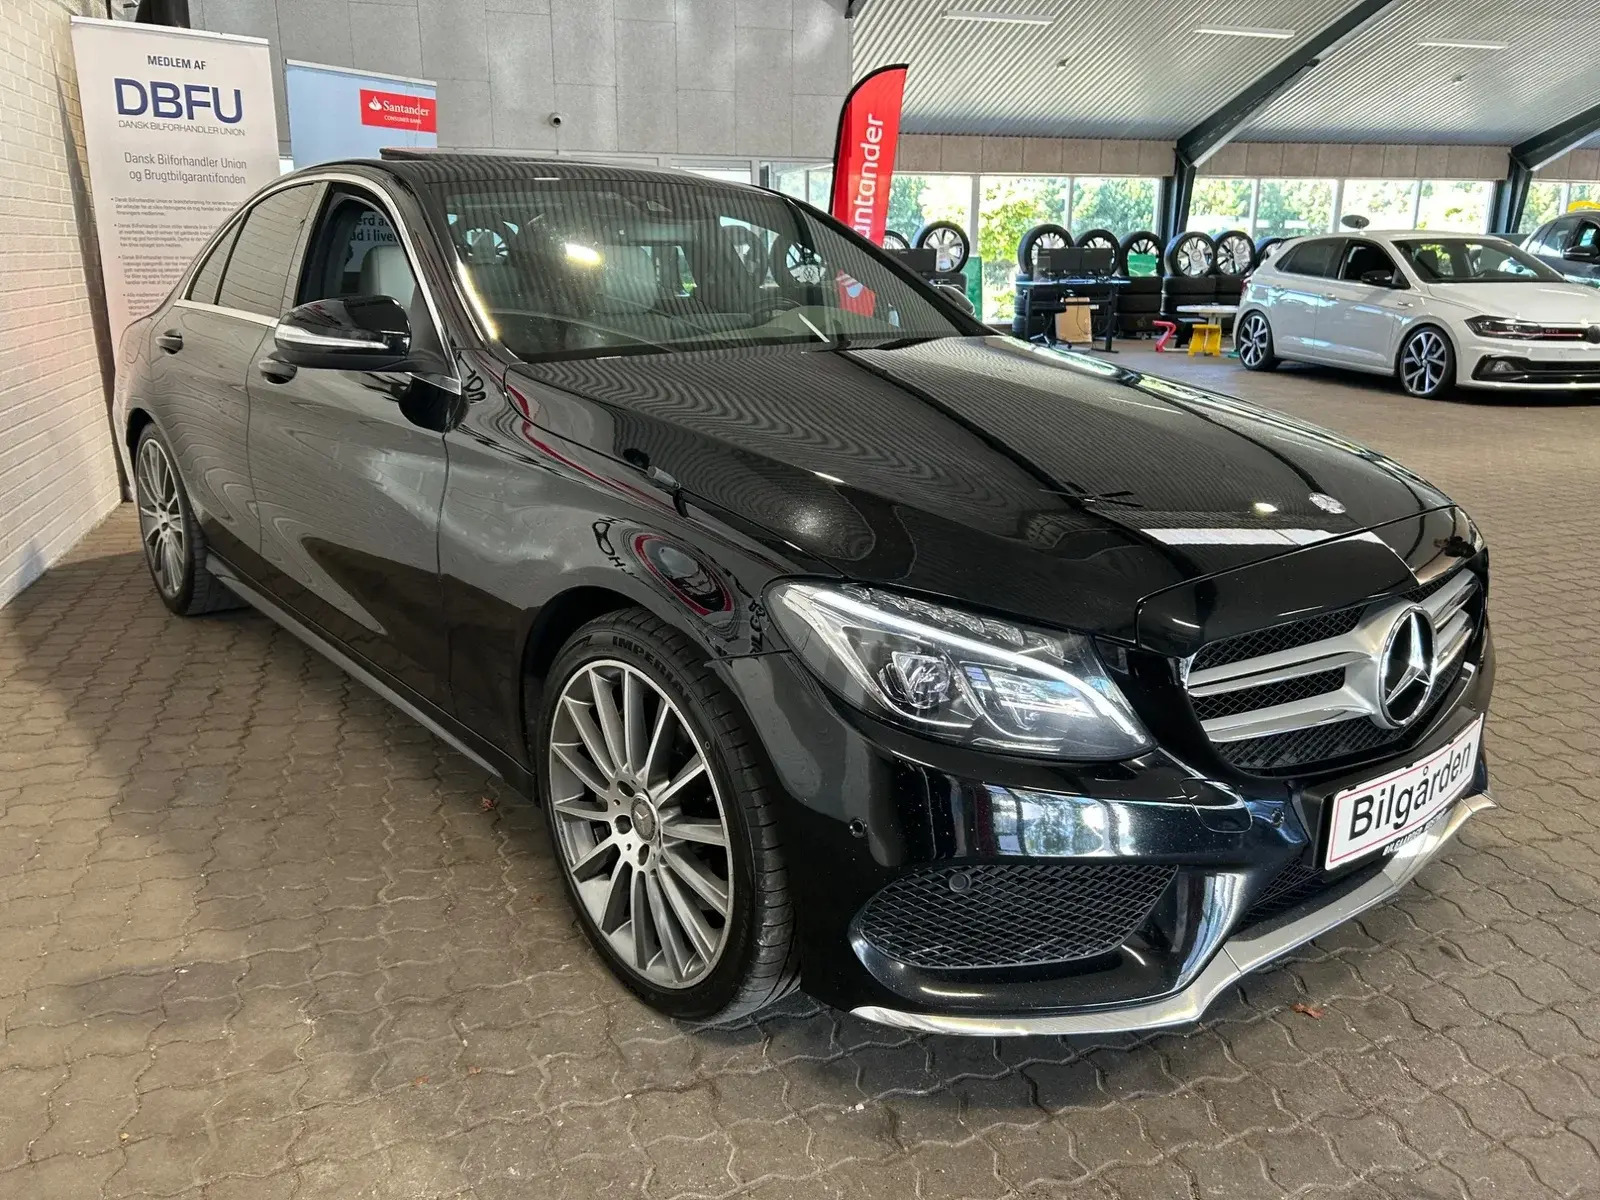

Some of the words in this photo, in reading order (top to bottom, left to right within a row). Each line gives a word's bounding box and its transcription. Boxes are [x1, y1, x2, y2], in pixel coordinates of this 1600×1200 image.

[147, 55, 191, 69] MEDLEM
[194, 60, 207, 70] AF
[114, 78, 243, 124] DBFU
[383, 100, 430, 116] Santander
[118, 120, 149, 129] DANSK
[150, 122, 219, 134] BILFORHANDLER
[220, 127, 245, 137] UNION
[124, 151, 155, 164] Dansk
[157, 153, 218, 168] Bilforhandler
[220, 157, 247, 169] Union
[129, 170, 142, 182] og
[144, 168, 246, 184] Brugtbilgarantifonden
[373, 229, 398, 241] live
[612, 635, 690, 699] IMPERIAL
[1348, 742, 1472, 840] Bilgården
